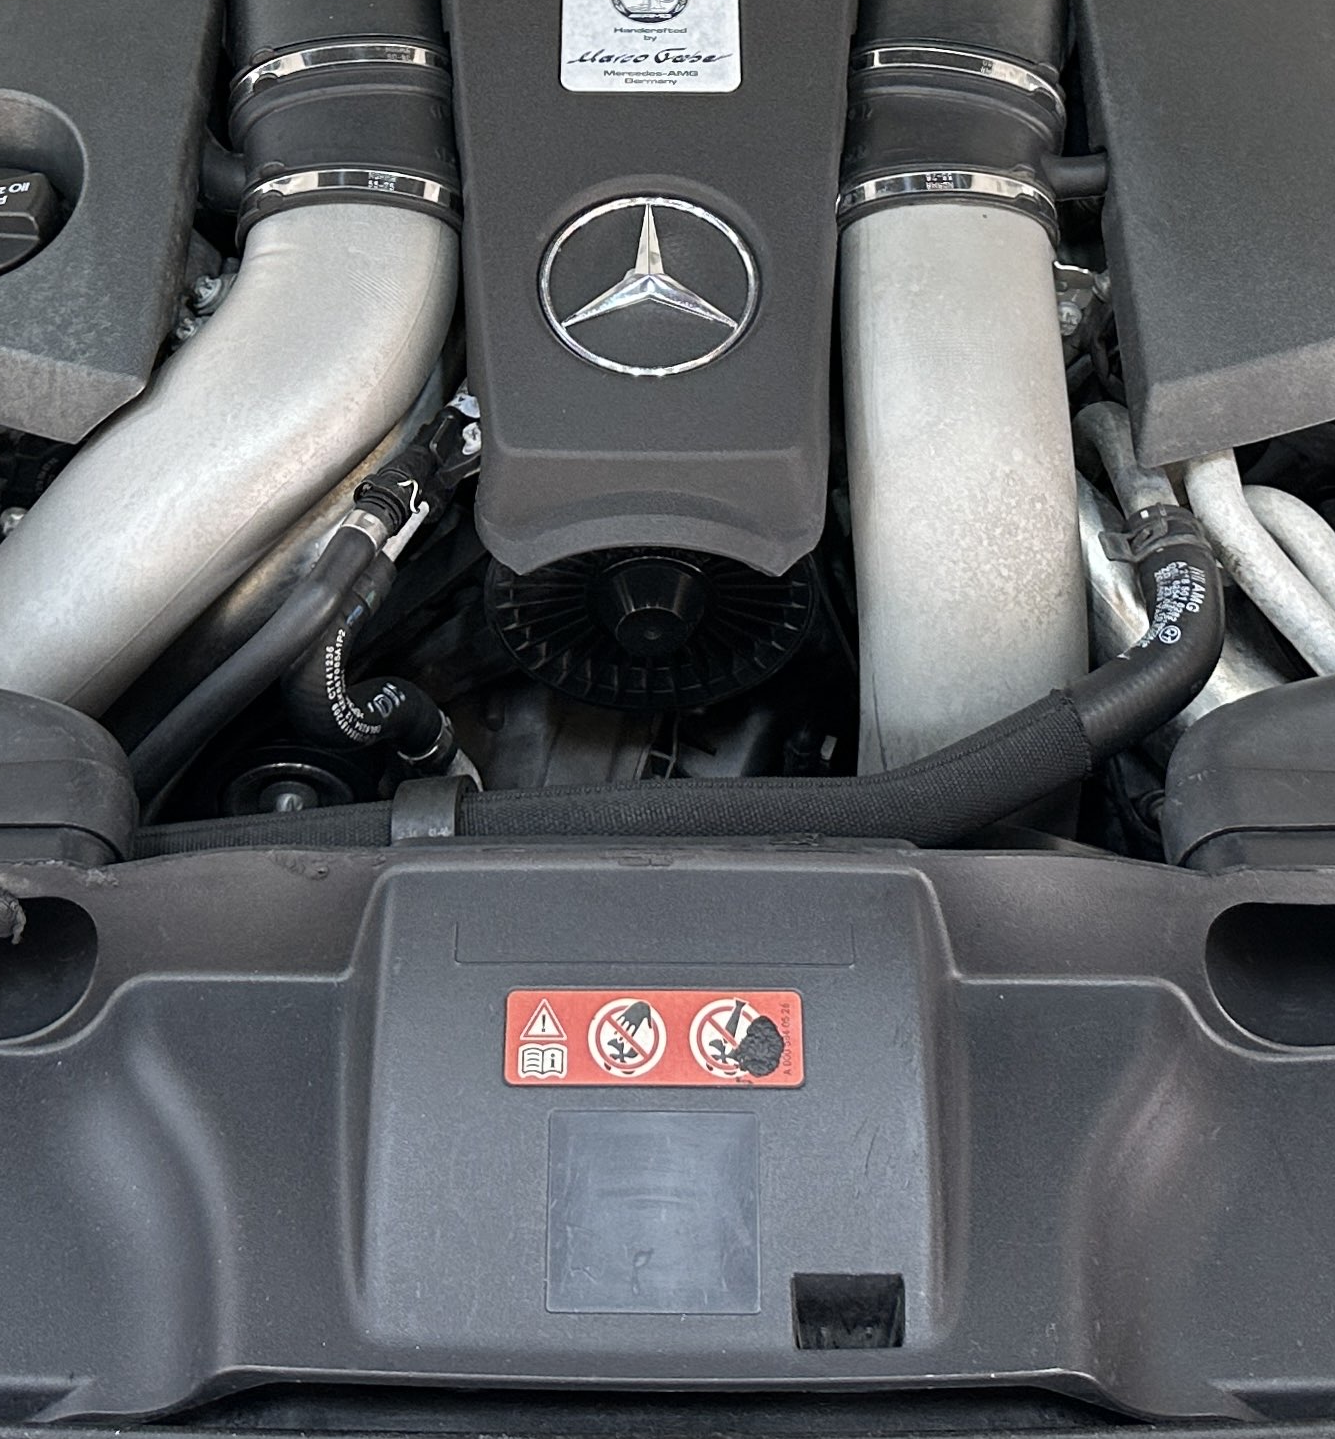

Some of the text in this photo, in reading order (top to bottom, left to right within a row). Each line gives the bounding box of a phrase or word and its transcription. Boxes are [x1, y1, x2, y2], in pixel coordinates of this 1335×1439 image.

[613, 26, 688, 34] Handcrafted
[643, 34, 657, 42] by
[603, 69, 699, 77] Mercedes-AMG
[624, 77, 678, 86] Germany
[8, 181, 31, 194] Oil
